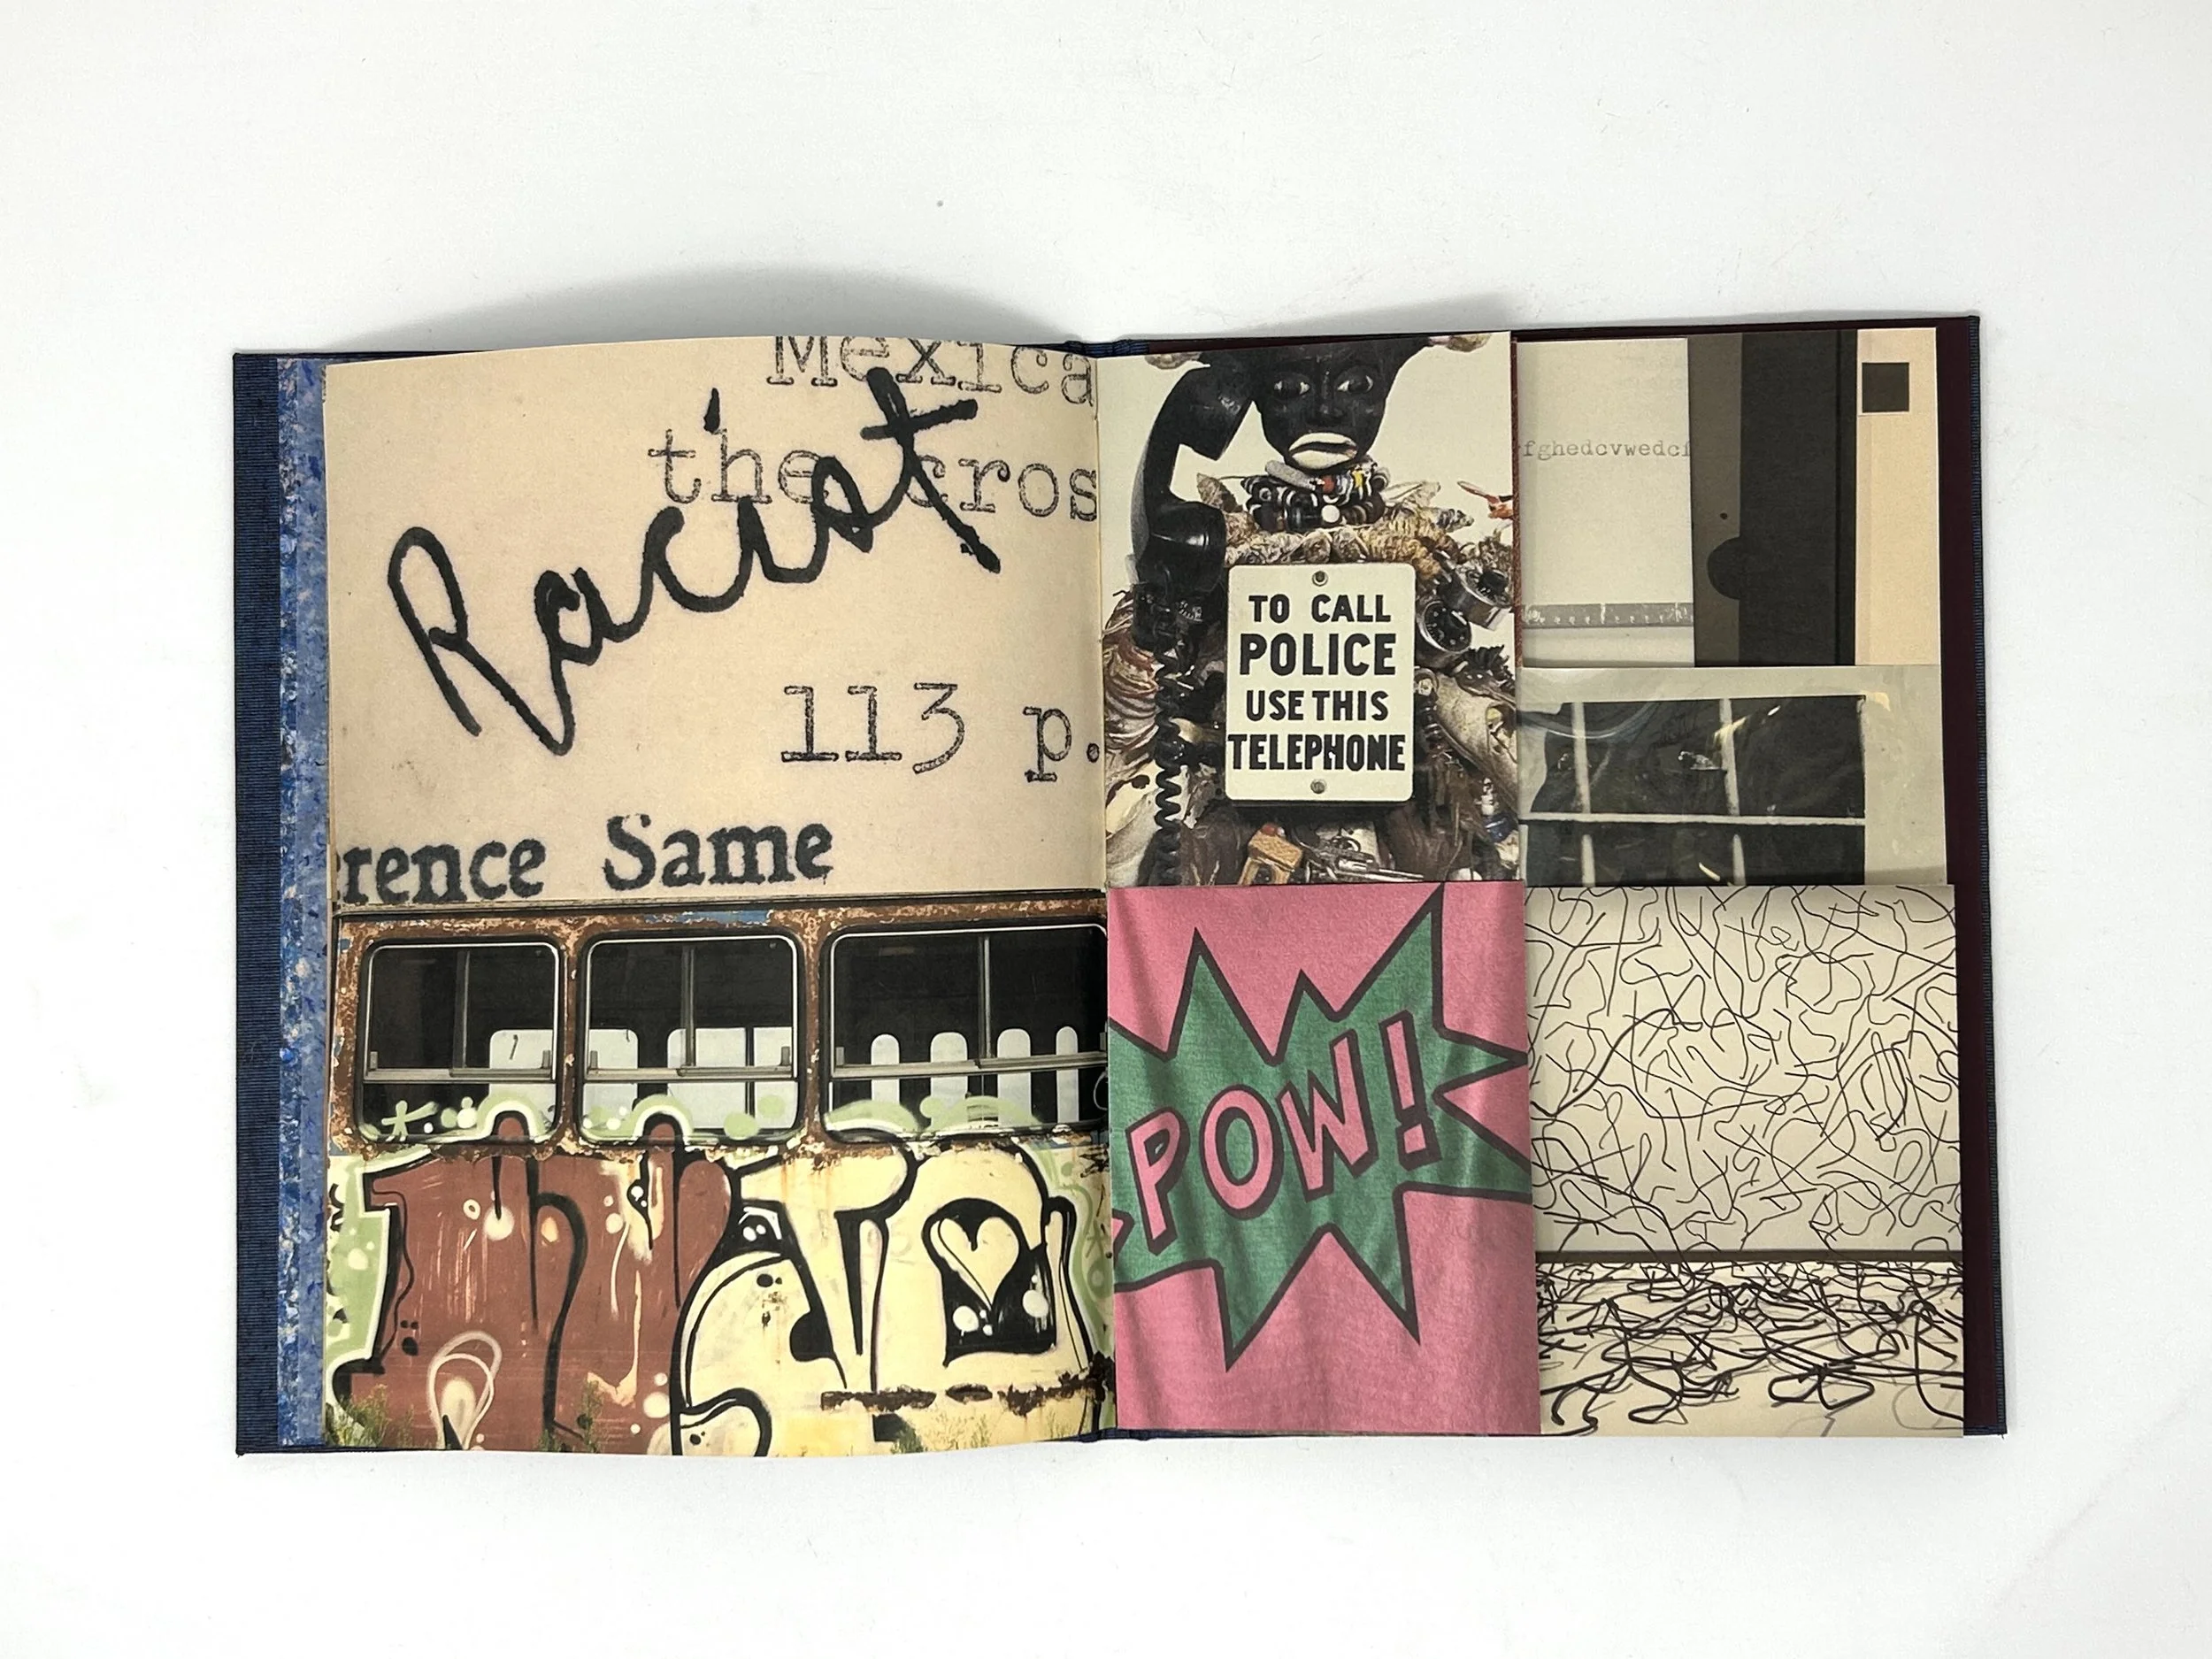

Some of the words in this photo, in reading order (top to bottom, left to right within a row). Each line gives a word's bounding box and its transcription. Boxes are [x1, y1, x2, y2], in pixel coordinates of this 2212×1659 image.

[647, 428, 828, 505] the
[904, 454, 1097, 522] cros
[1248, 594, 1290, 624] TO
[1311, 594, 1392, 623] CALL
[1239, 633, 1396, 676] POLICE
[781, 682, 965, 773] 113
[1023, 706, 1100, 782] p.
[1246, 690, 1304, 721] USE
[1312, 690, 1389, 721] THIS
[1227, 733, 1406, 772] TELEPHONE
[336, 837, 547, 905] rence
[603, 811, 834, 892] Same
[1125, 1009, 1442, 1256] POW!
